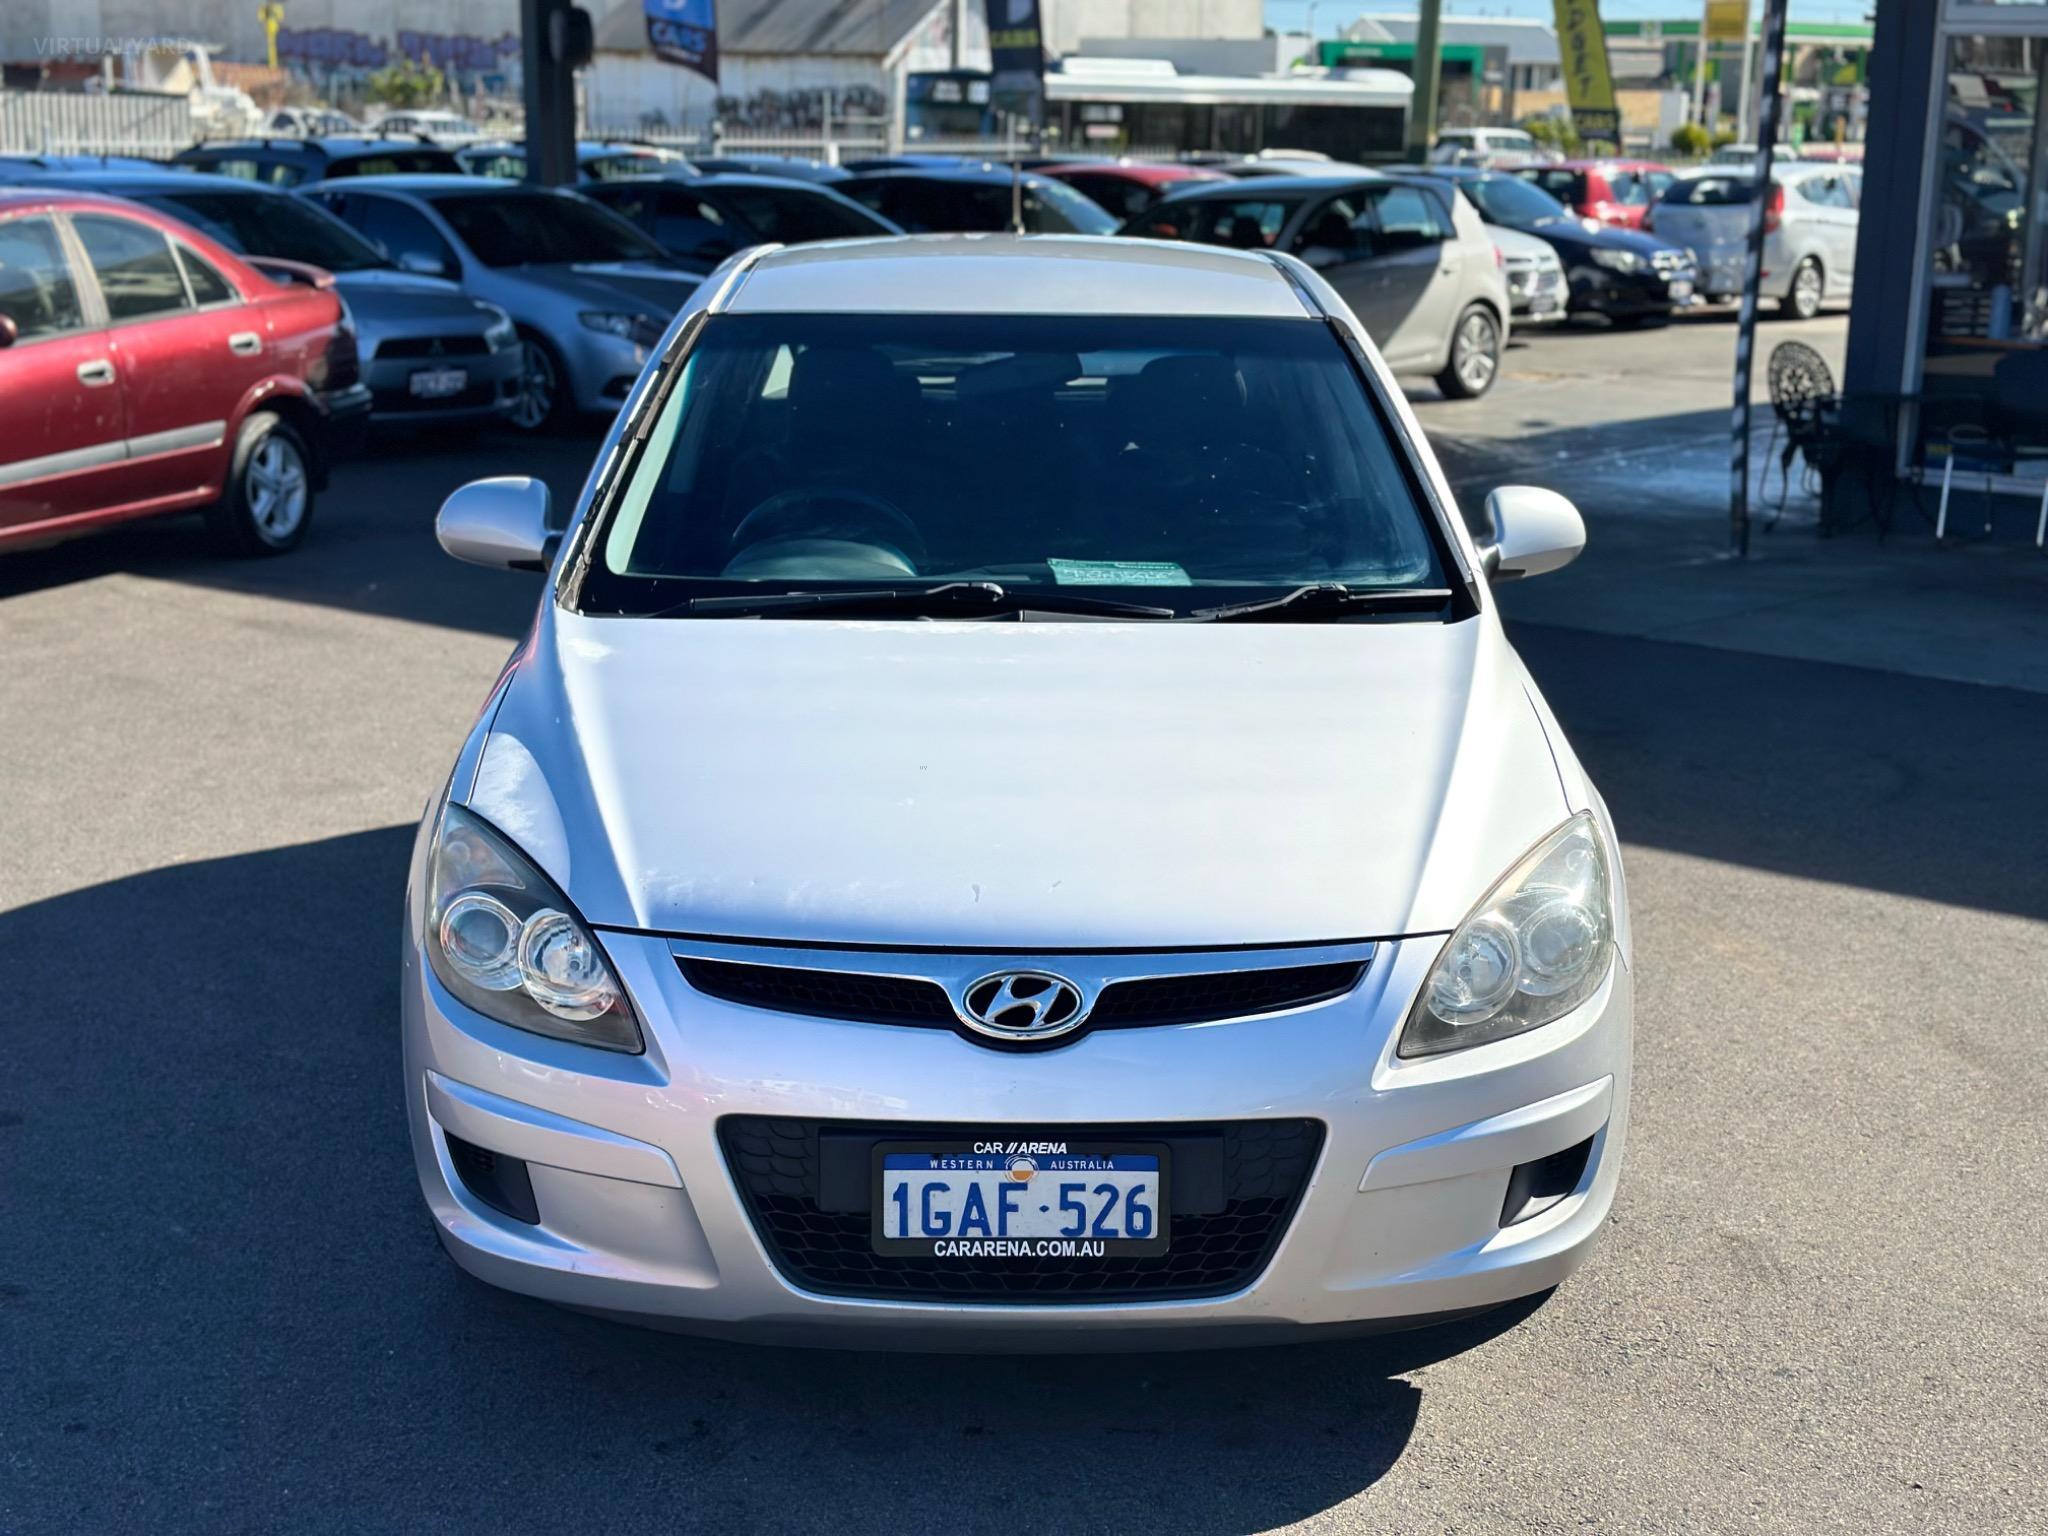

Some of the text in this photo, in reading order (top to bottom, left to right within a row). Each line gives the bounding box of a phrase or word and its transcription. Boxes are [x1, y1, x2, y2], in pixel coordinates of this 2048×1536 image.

[973, 1142, 1003, 1154] CAR
[929, 1159, 1114, 1170] WESTERN AUSTRALIA
[934, 1241, 1105, 1257] CARARENA.COM.AU
